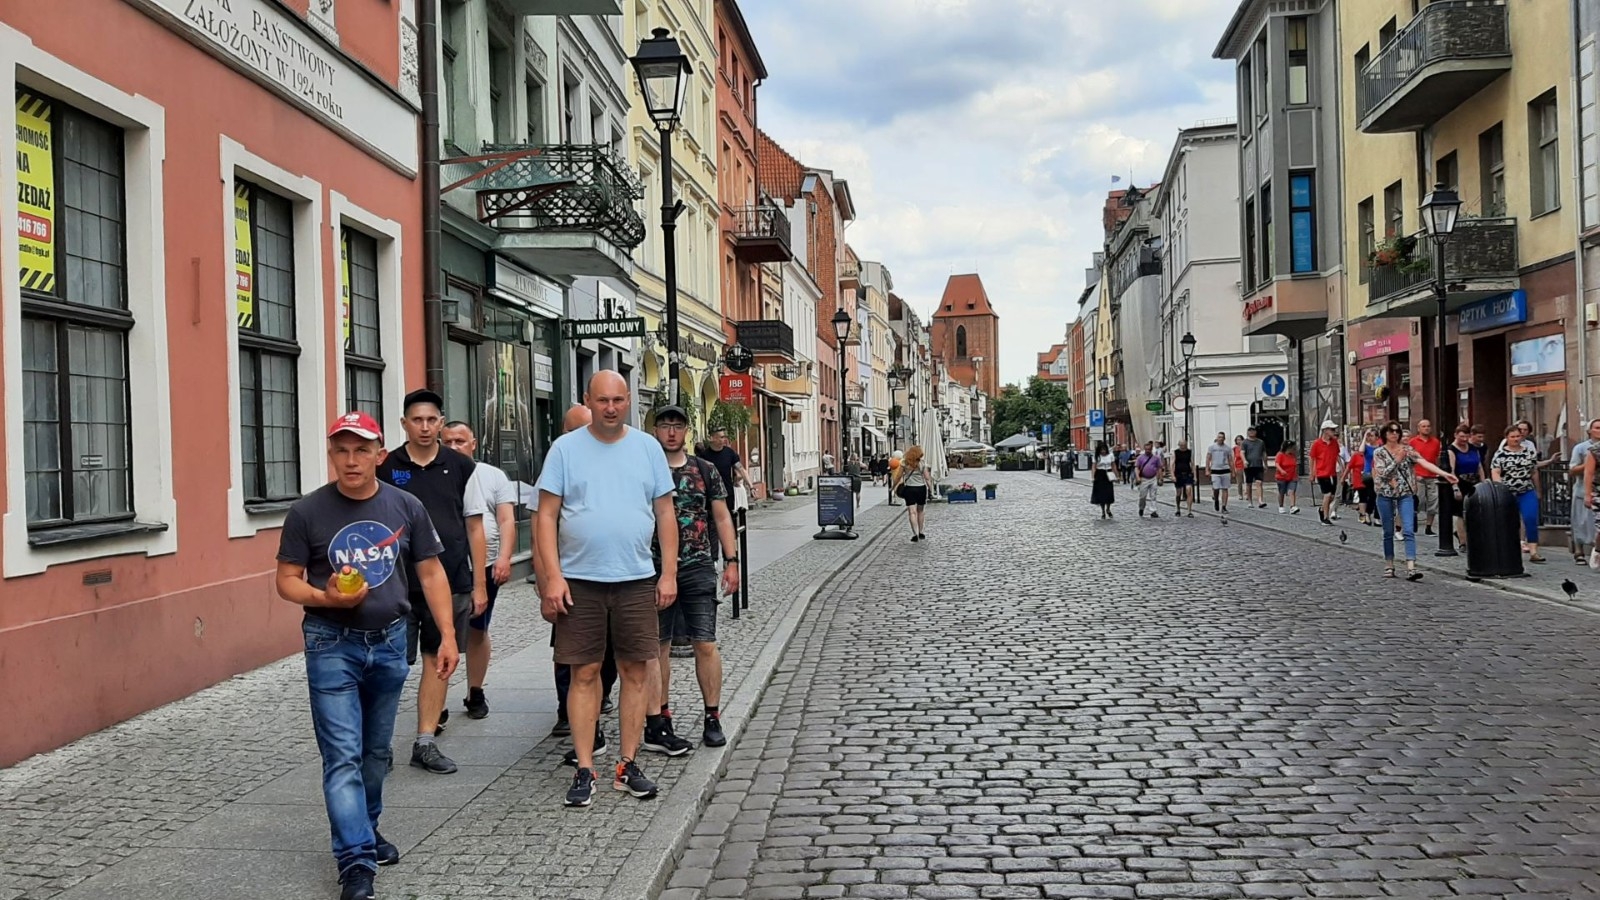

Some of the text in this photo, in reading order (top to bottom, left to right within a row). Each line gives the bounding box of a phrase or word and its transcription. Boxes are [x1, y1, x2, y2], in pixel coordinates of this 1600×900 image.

[252, 10, 335, 86] PAŃSTWOWY
[184, 0, 272, 71] ZAŁOŻONY
[275, 56, 290, 81] W
[291, 69, 316, 101] 1924
[316, 92, 343, 119] roku
[32, 221, 47, 238] 766
[514, 274, 549, 302] ALKOHOLE
[1460, 296, 1517, 323] OPTYK HOYA
[576, 321, 640, 335] MONOPOLOWY
[728, 379, 743, 388] JBB
[1092, 410, 1101, 422] P
[335, 545, 395, 564] NASA
